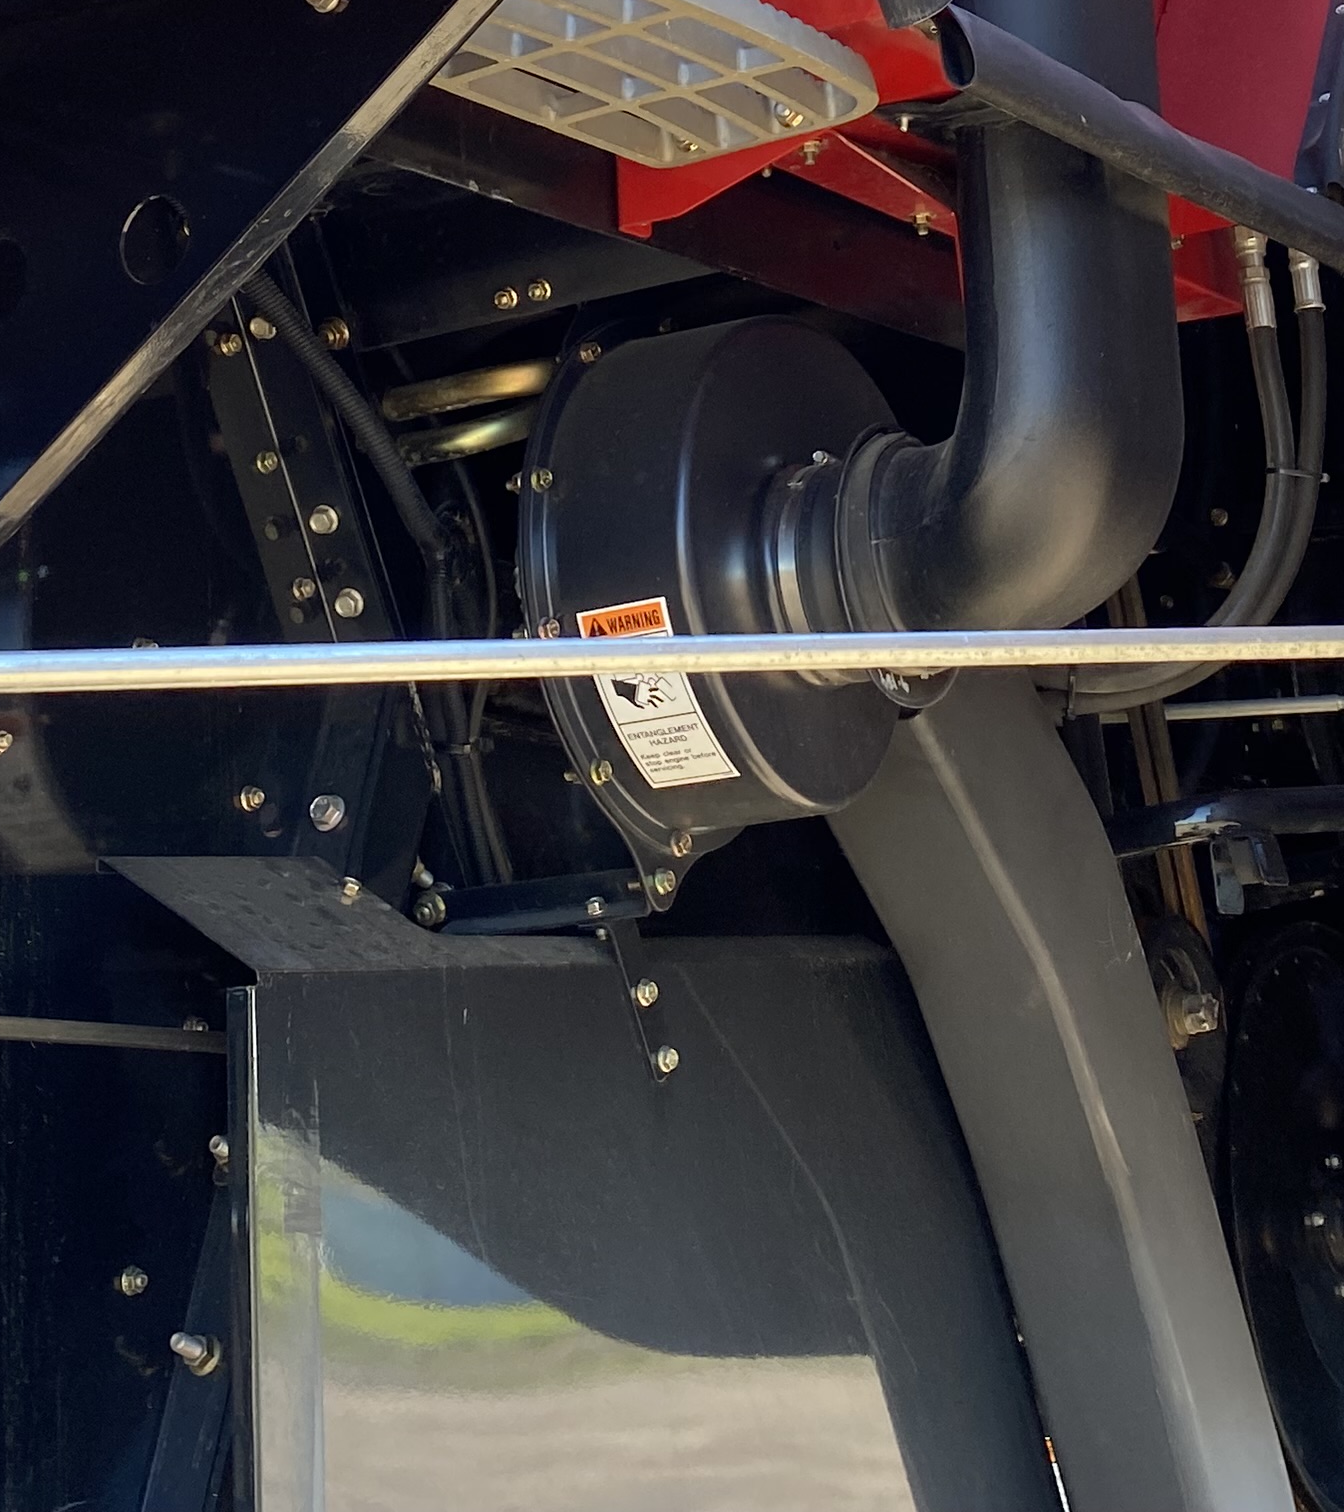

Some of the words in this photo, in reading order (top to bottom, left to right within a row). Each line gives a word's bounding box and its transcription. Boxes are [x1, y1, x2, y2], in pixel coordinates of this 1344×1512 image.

[606, 609, 661, 635] WARNING
[627, 723, 699, 741] ENTANGLEMENT
[649, 734, 688, 747] HAZARD
[640, 753, 661, 761] Keep
[645, 759, 663, 767] stop
[664, 755, 690, 764] engine
[691, 751, 717, 760] before
